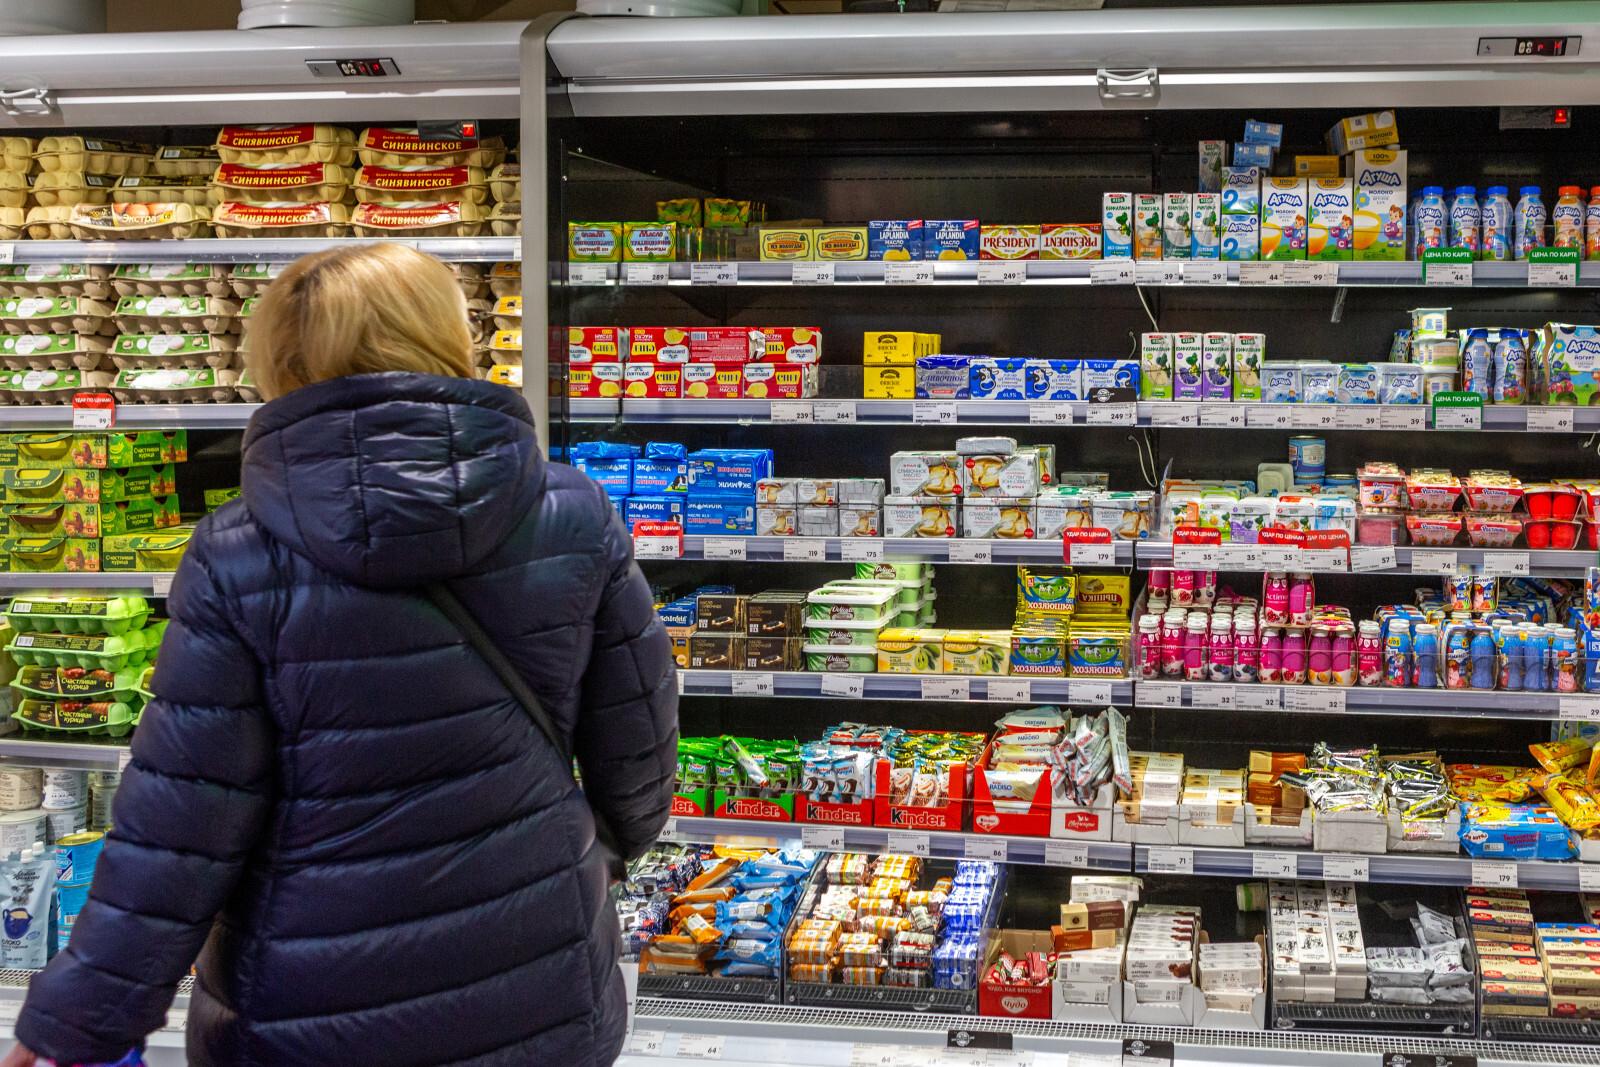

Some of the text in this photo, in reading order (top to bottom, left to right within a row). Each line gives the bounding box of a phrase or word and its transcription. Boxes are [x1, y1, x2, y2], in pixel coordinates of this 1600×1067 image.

[232, 135, 299, 146] СИНЯВИНСКОЕ
[382, 140, 462, 151] СИНЯВИНСКОЕ
[232, 175, 307, 185] СИНЯВИНСКОЕ
[375, 178, 452, 188] СИНЯВИНСКОЕ
[1359, 169, 1401, 186] АГУША
[1223, 189, 1239, 212] 2
[121, 213, 157, 224] Экстра
[879, 231, 910, 240] LAPLANDIA
[935, 231, 965, 240] LAPLANDIA
[983, 235, 1036, 249] PRÉSIDENT
[1223, 237, 1239, 260] 2
[746, 370, 770, 378] parmalat
[85, 471, 95, 480] 20
[1027, 602, 1073, 611] ХОЗЯЮШКА
[1013, 665, 1062, 674] ХОЗЯЮШКА
[1072, 666, 1122, 675] ХОЗЯЮШКА
[67, 682, 89, 690] курица
[725, 798, 778, 817] Kinder
[806, 803, 859, 823] Kinder
[890, 808, 944, 827] Kinder
[1003, 999, 1026, 1011] Чудо
